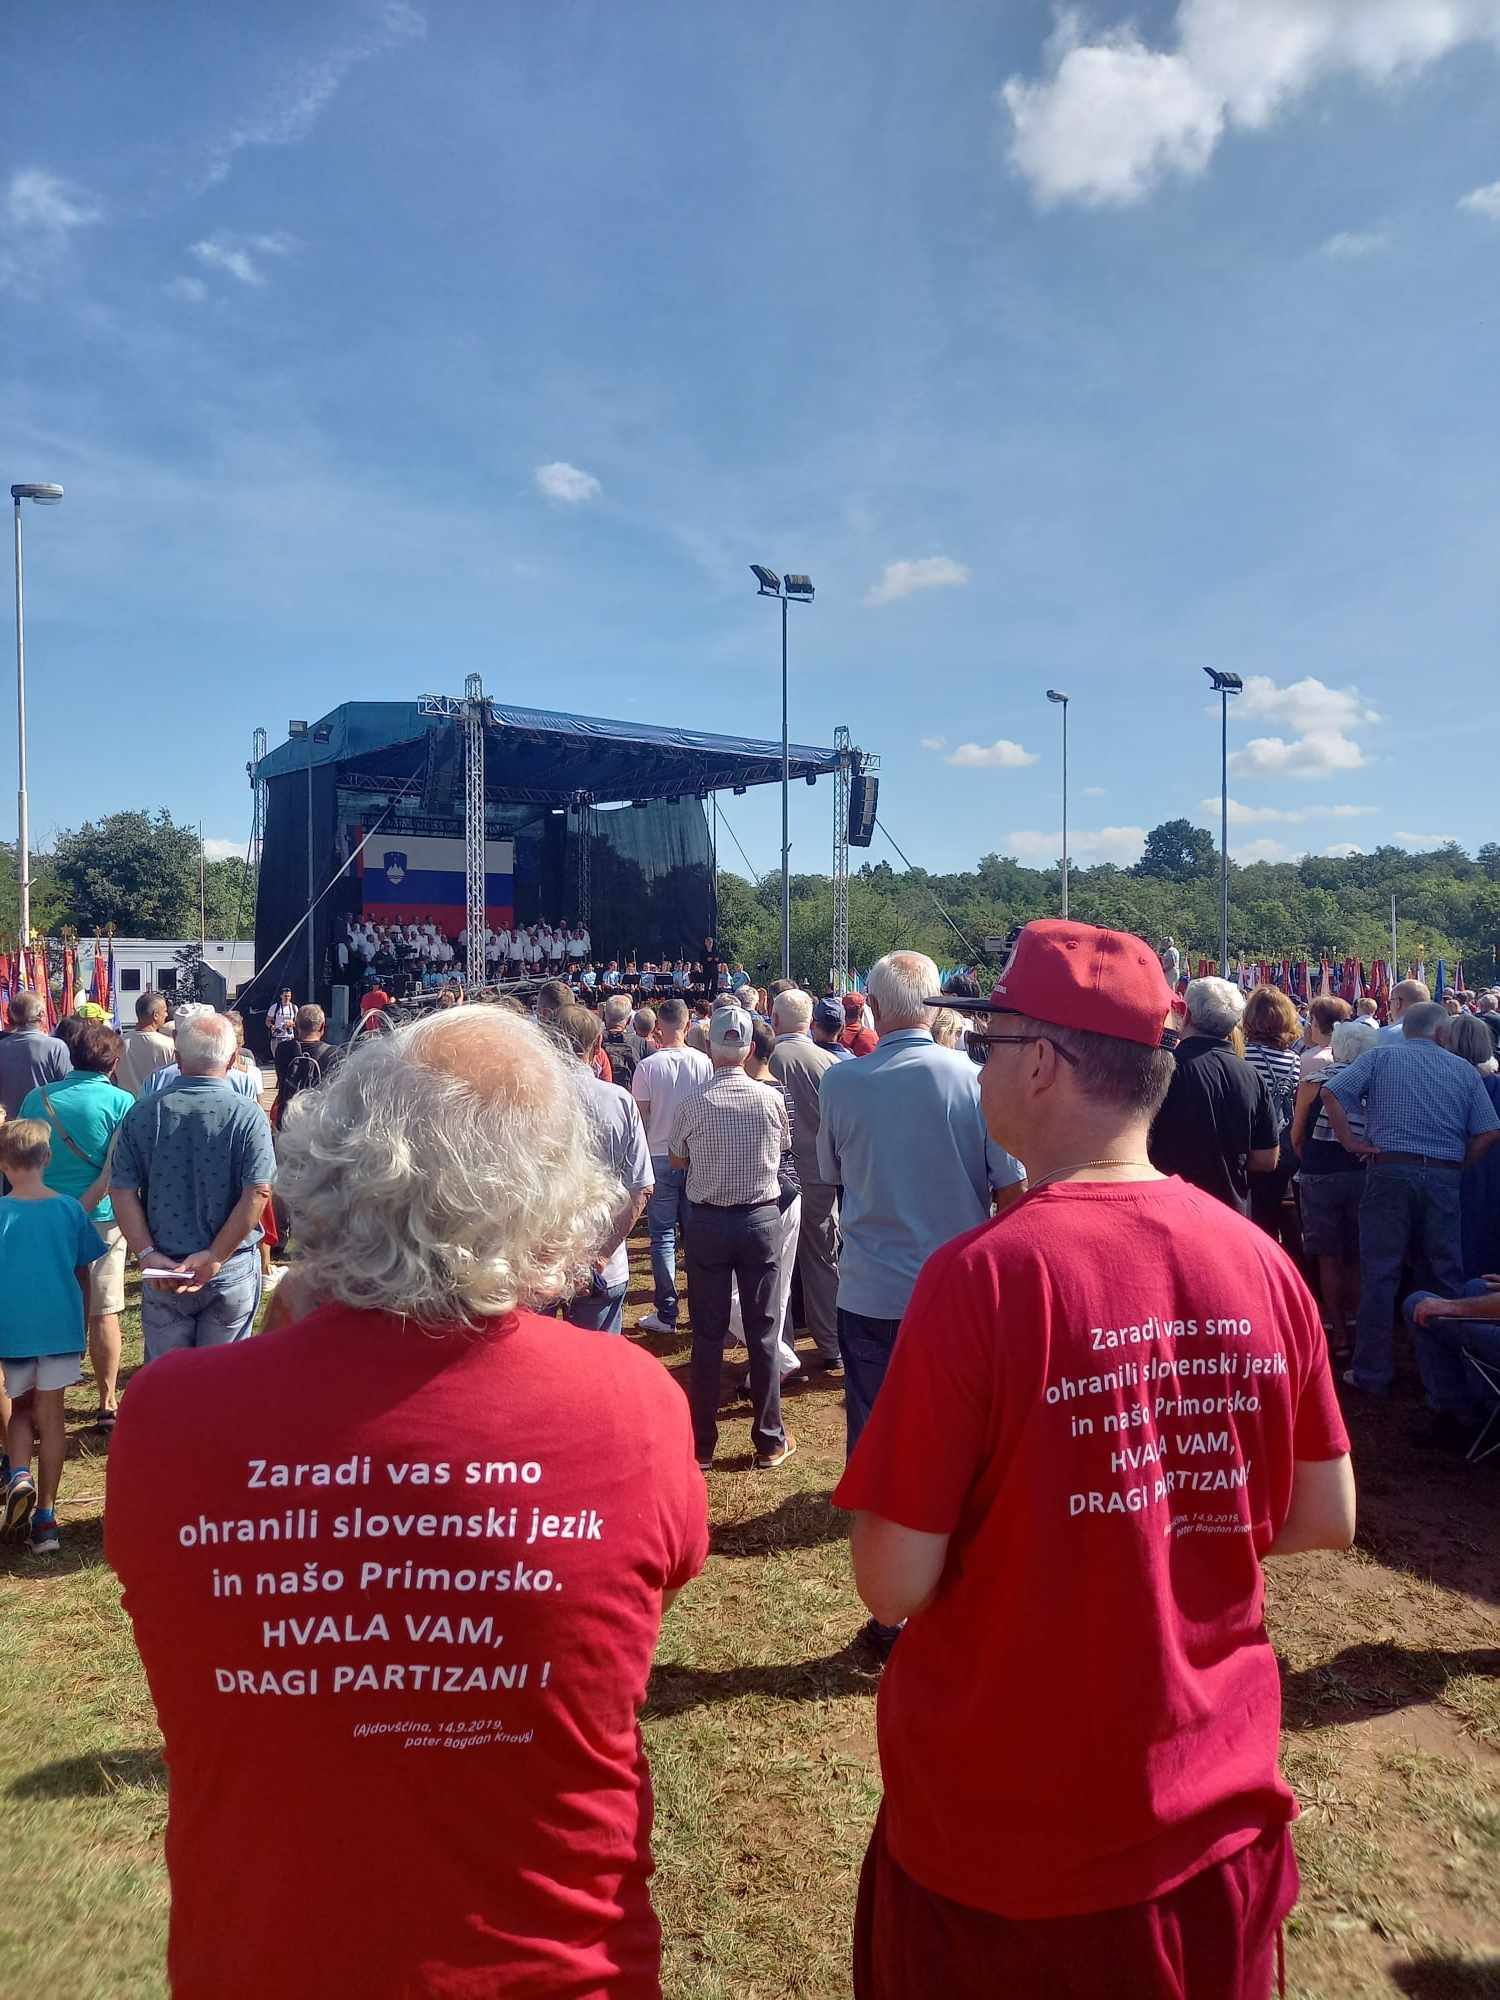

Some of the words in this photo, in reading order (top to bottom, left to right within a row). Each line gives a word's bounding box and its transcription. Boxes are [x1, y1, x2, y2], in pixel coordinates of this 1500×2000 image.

[1090, 1316, 1160, 1350] Zaradi
[1163, 1319, 1198, 1337] vas
[1205, 1318, 1252, 1336] smo
[1046, 1362, 1138, 1404] ohranili
[1142, 1352, 1238, 1381] slovenski
[1242, 1352, 1287, 1379] jezik
[1071, 1415, 1094, 1437] in
[1103, 1402, 1150, 1432] našo
[1111, 1434, 1168, 1473] HVALA
[1175, 1431, 1235, 1455] VAM,
[247, 1455, 371, 1488] Zaradi
[386, 1461, 450, 1485] vas
[464, 1460, 542, 1484] smo
[1069, 1485, 1148, 1516] DRAGI
[179, 1508, 318, 1546] ohranili
[332, 1506, 518, 1539] slovenski
[526, 1506, 603, 1544] jezik
[212, 1568, 243, 1597] in
[256, 1562, 344, 1595] našo
[360, 1560, 563, 1592] Primorsko.
[263, 1613, 390, 1648] HVALA
[405, 1613, 504, 1648] VAM,
[215, 1667, 318, 1696] DRAGI
[333, 1663, 529, 1692] PARTIZANI
[540, 1661, 551, 1688] !
